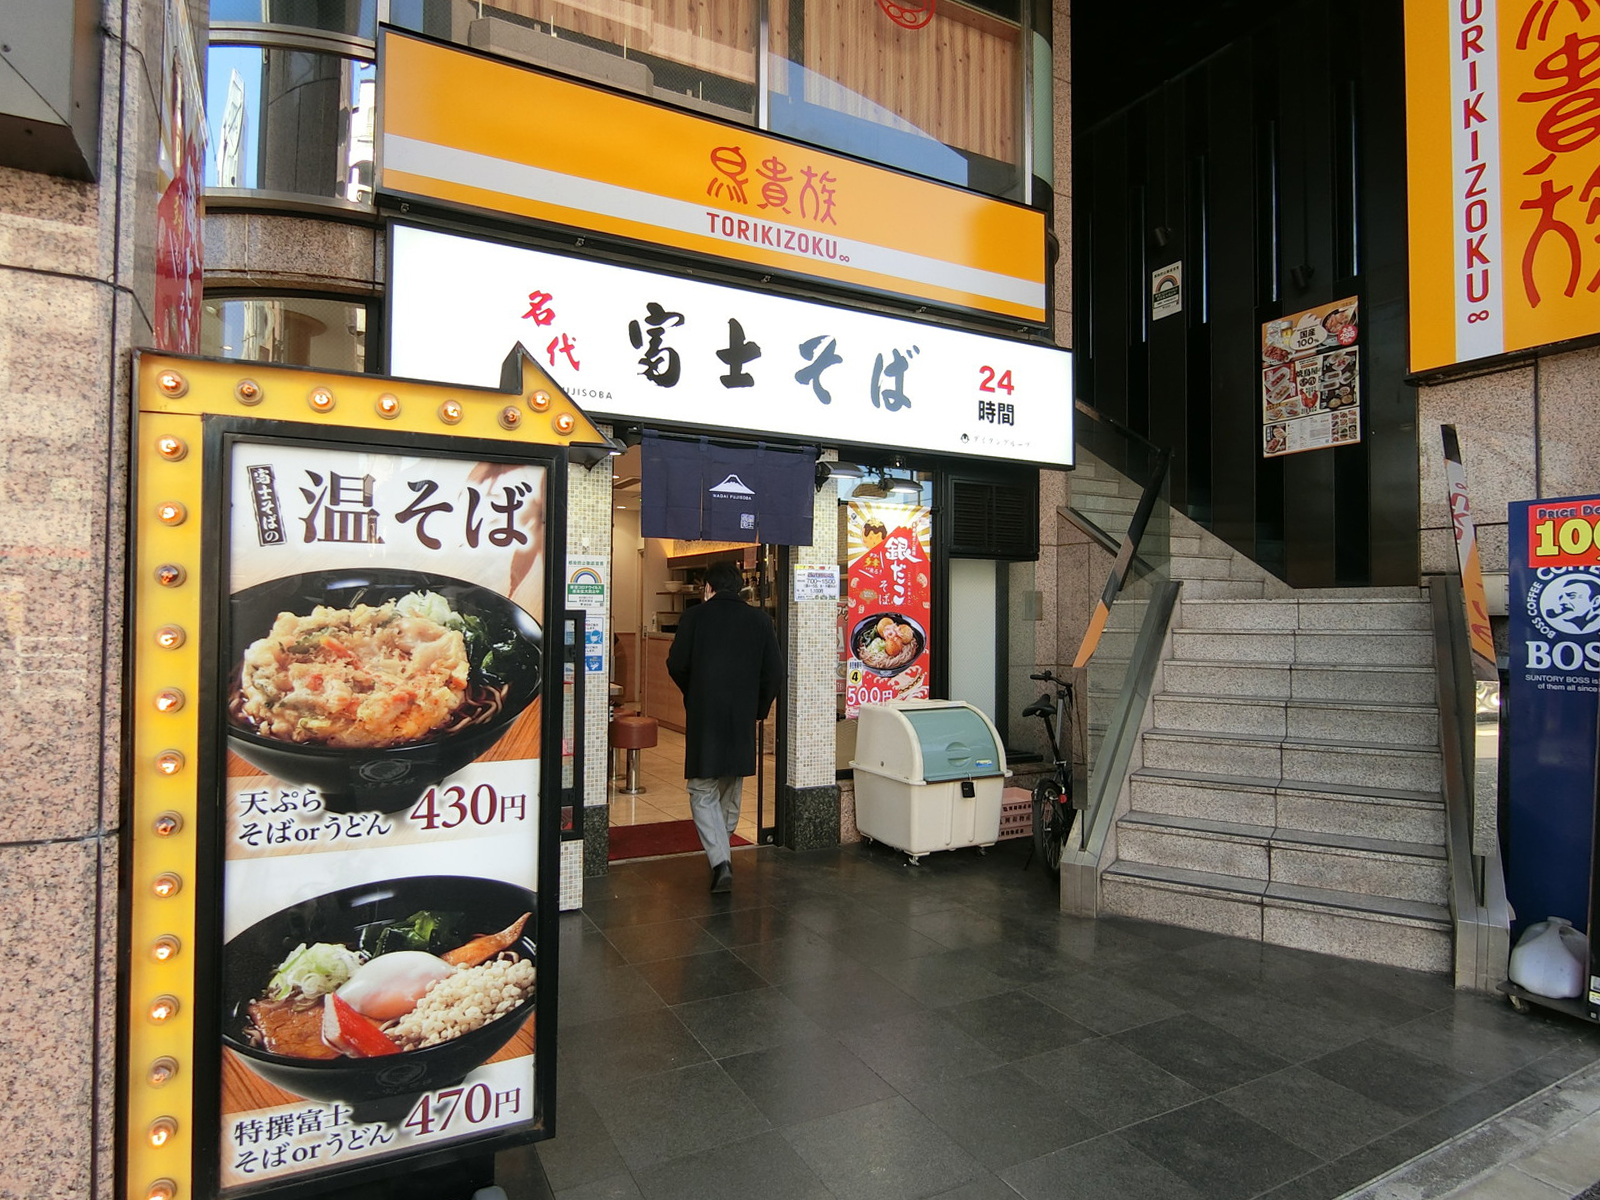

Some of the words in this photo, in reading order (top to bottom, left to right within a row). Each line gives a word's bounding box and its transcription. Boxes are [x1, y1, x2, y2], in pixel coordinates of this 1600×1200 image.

[1516, 0, 1600, 308] 貴族
[706, 146, 837, 226] 鳥貴族
[706, 212, 838, 259] TORIKIZOKU
[521, 290, 580, 371] 名代
[628, 302, 920, 412] 富士そば
[562, 386, 612, 400] UJISOBA
[979, 366, 1015, 395] 24
[978, 400, 1015, 426] 時間
[253, 468, 279, 543] 富士そばの
[298, 469, 533, 550] 温そば
[1536, 518, 1600, 556] 10
[885, 536, 923, 605] 銀だこ
[1527, 581, 1543, 616] COFFEE
[853, 671, 859, 682] 4
[1525, 674, 1564, 683] SUNTORY
[1566, 676, 1590, 684] BOSS
[1577, 684, 1598, 692] since
[239, 789, 323, 818] 天ぷら
[410, 784, 527, 831] 430円
[238, 812, 392, 847] そばorうどん
[234, 1104, 352, 1147] 特撰富士
[405, 1083, 521, 1137] 470円
[234, 1124, 394, 1174] そばorうどん
